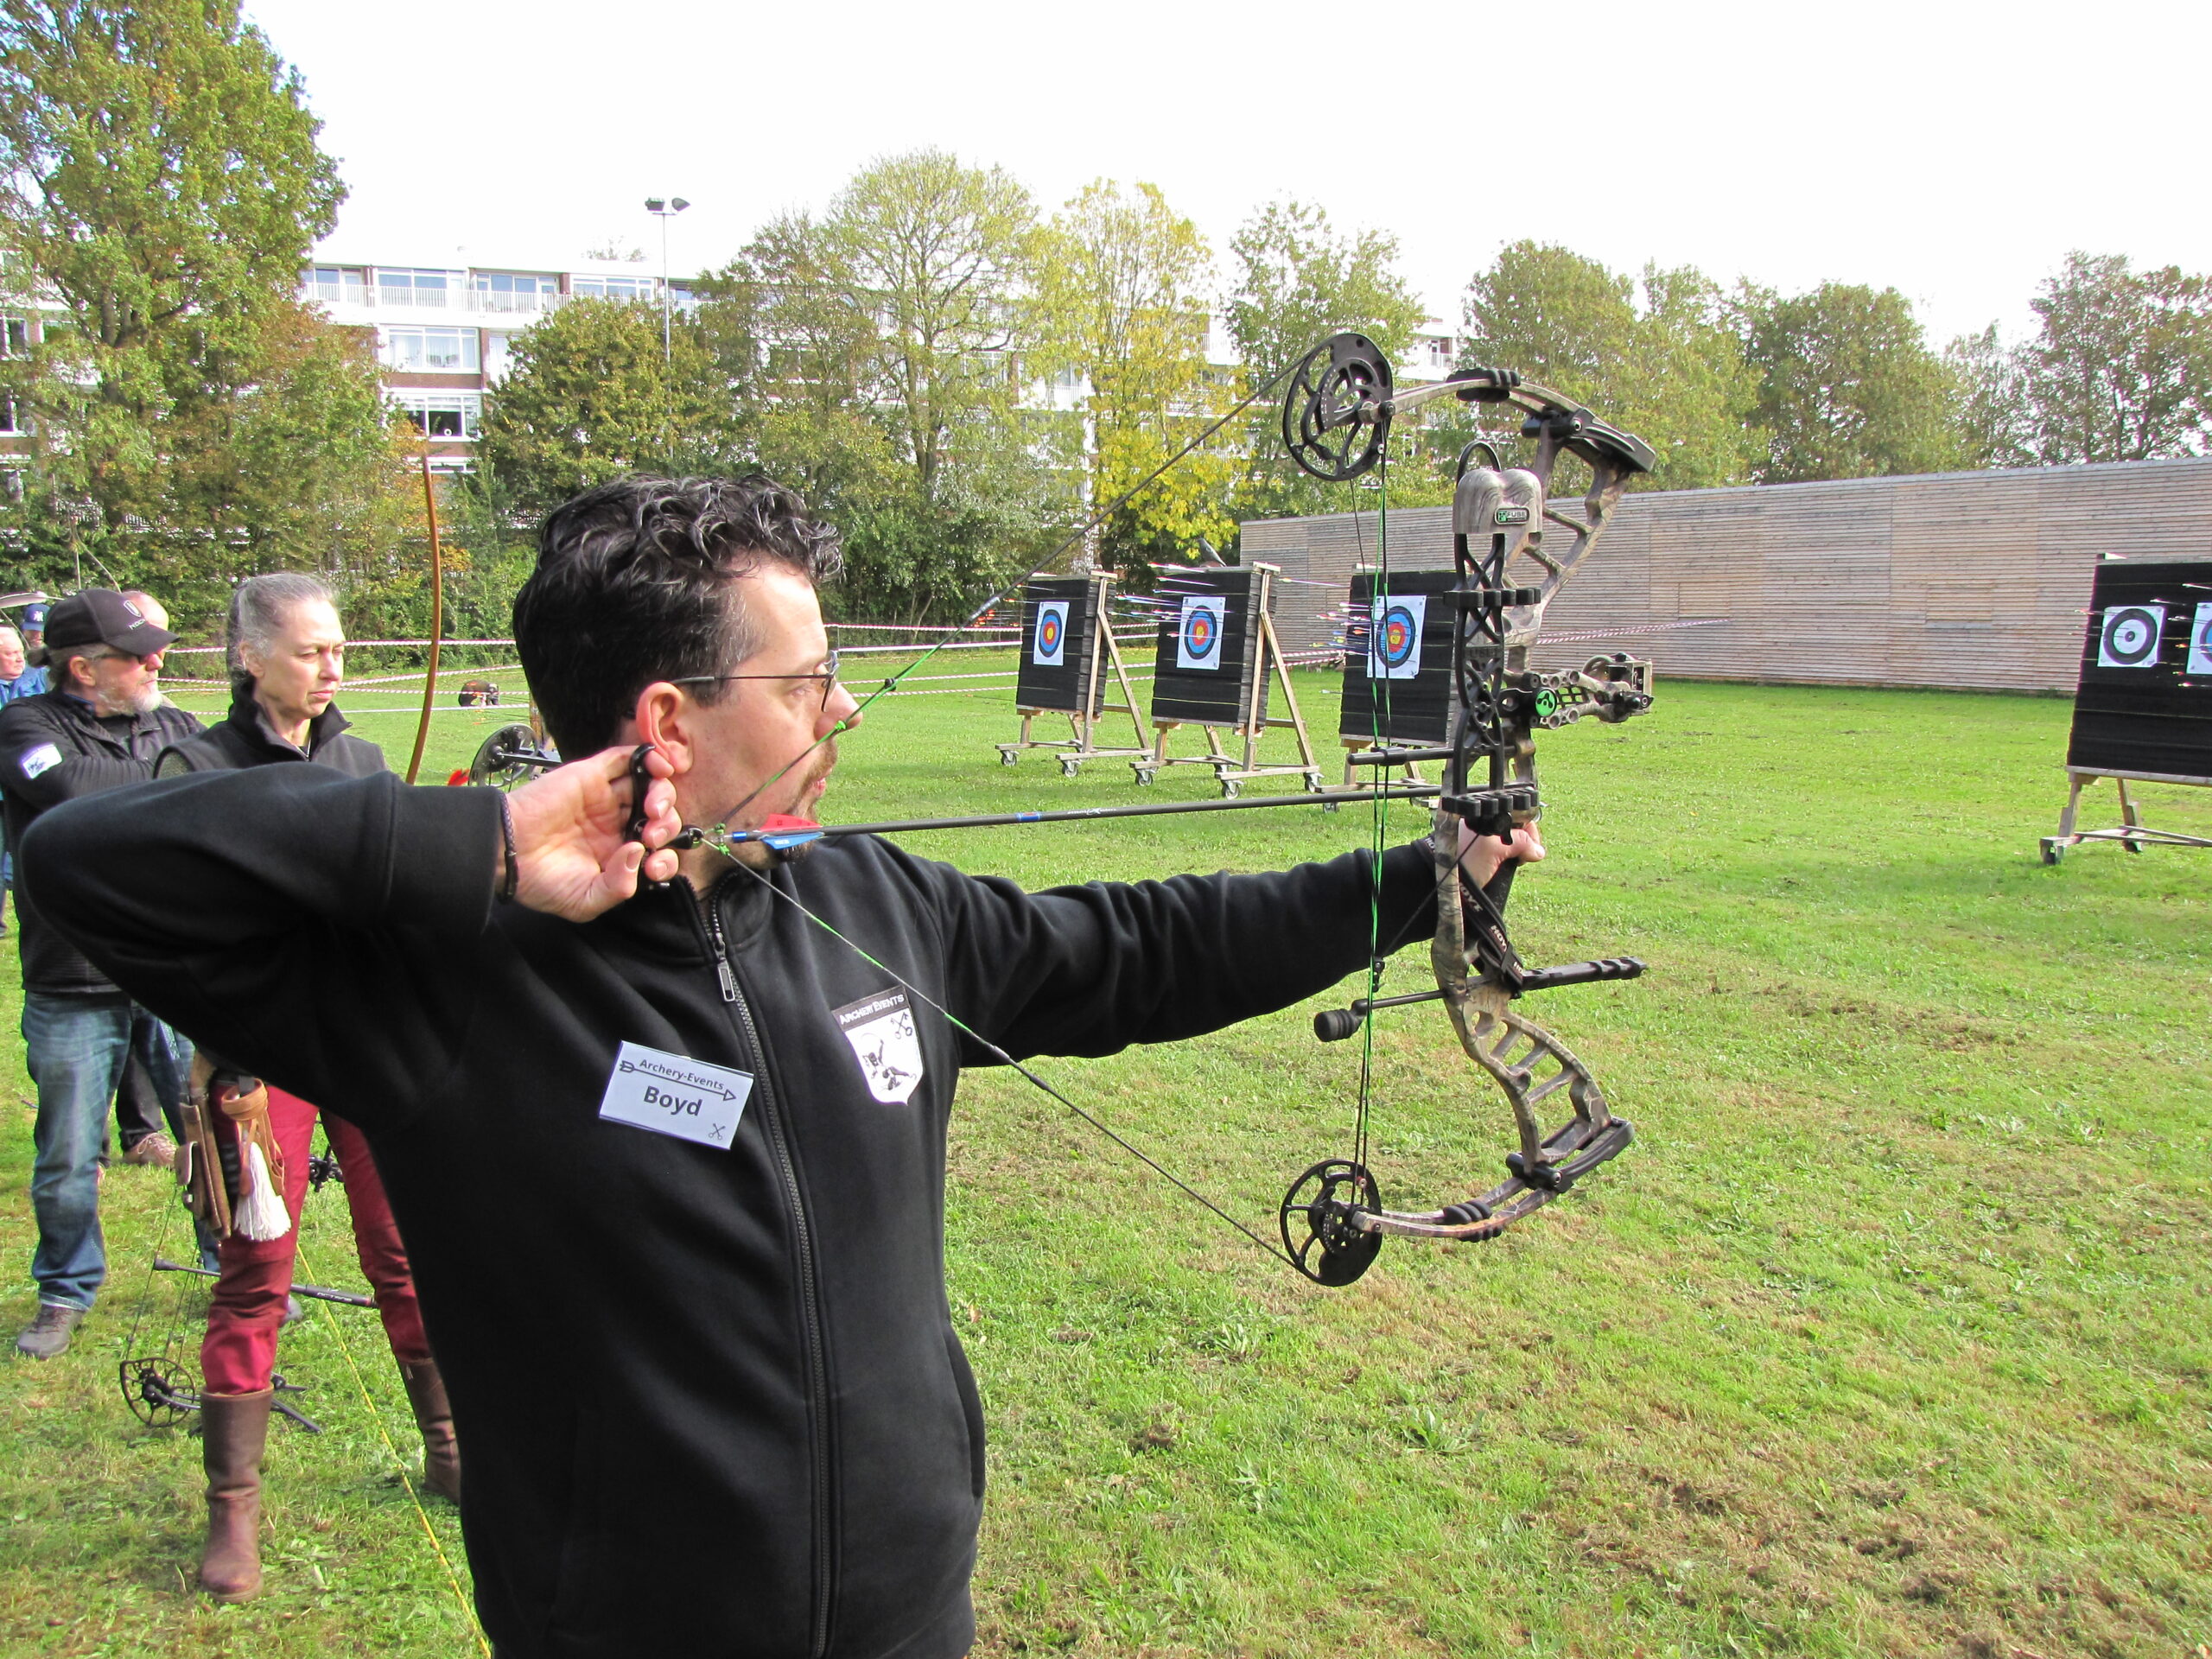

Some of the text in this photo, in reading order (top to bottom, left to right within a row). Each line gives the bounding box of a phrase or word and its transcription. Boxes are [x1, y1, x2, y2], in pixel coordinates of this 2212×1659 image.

[1491, 925, 1508, 952] HOY
[872, 994, 905, 1013] EVENTS
[639, 1058, 725, 1090] Archery-Events
[643, 1084, 703, 1116] Boyd
